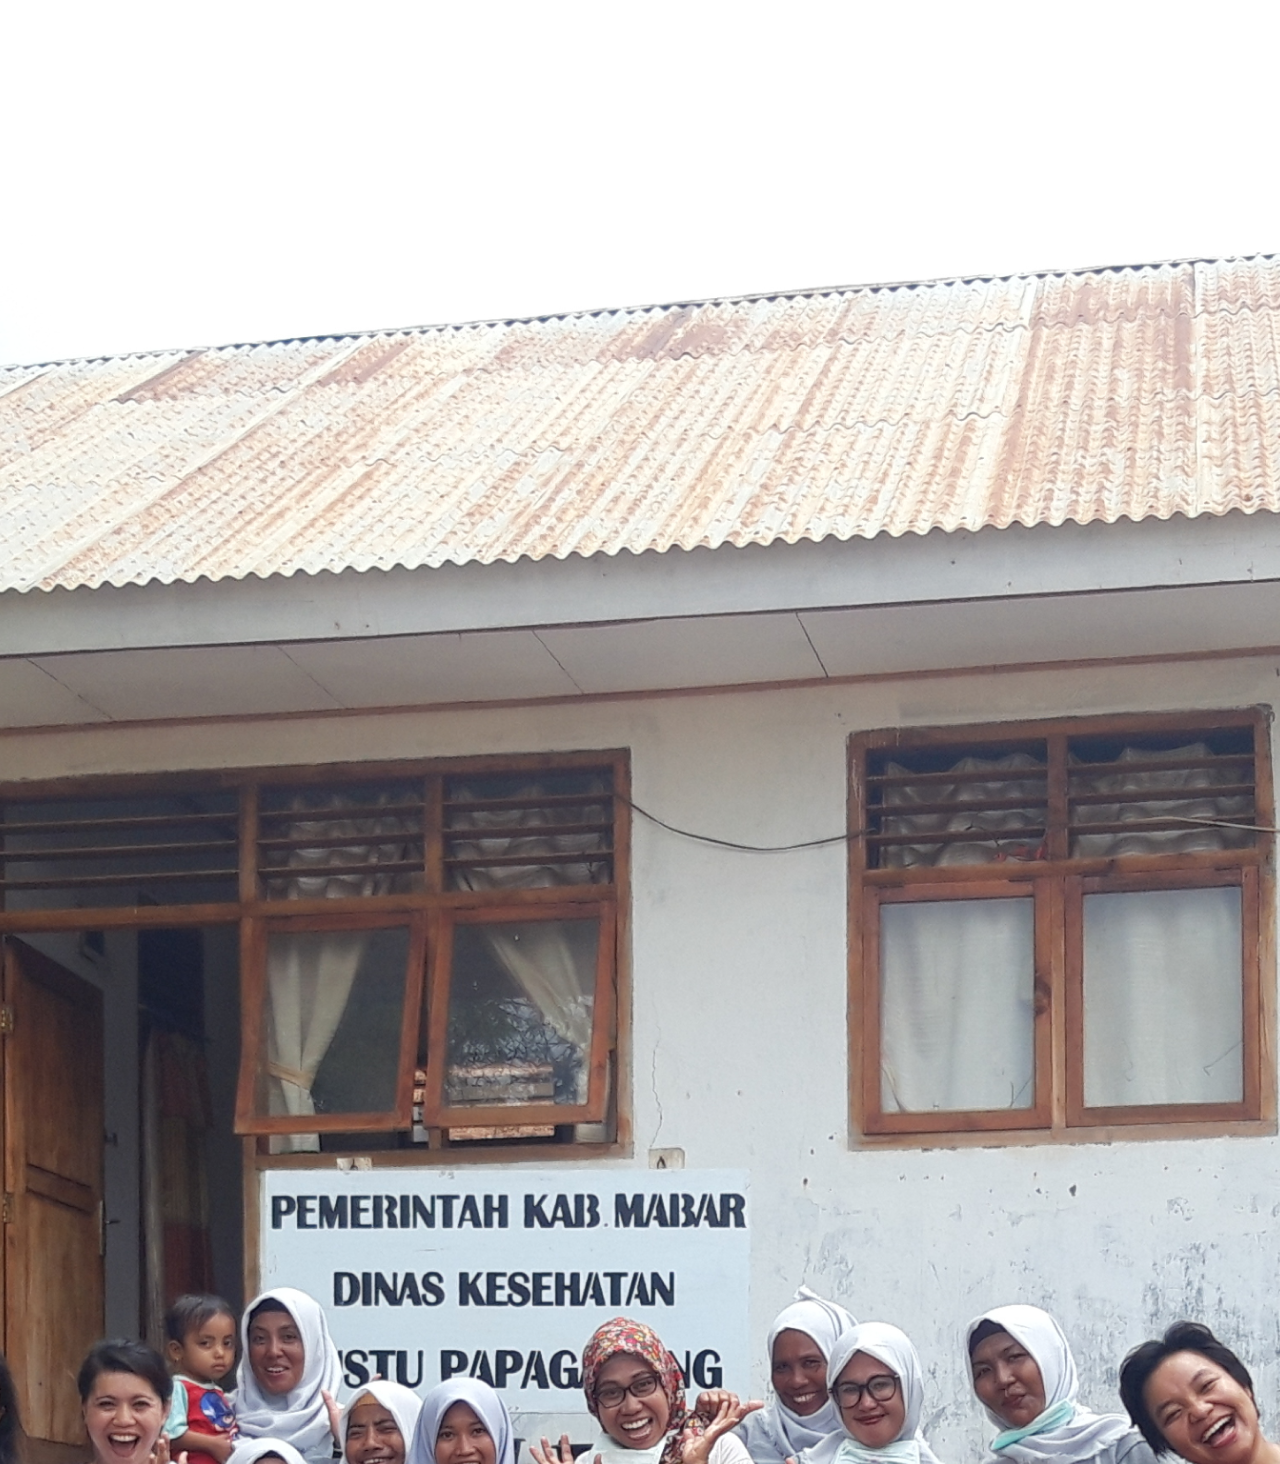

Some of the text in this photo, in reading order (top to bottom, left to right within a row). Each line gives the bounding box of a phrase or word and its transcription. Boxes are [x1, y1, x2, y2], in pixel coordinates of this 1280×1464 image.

[272, 1194, 508, 1229] PEMERINTAH
[615, 1193, 746, 1228] MABAR
[333, 1272, 674, 1306] DINAS KESEHATAN
